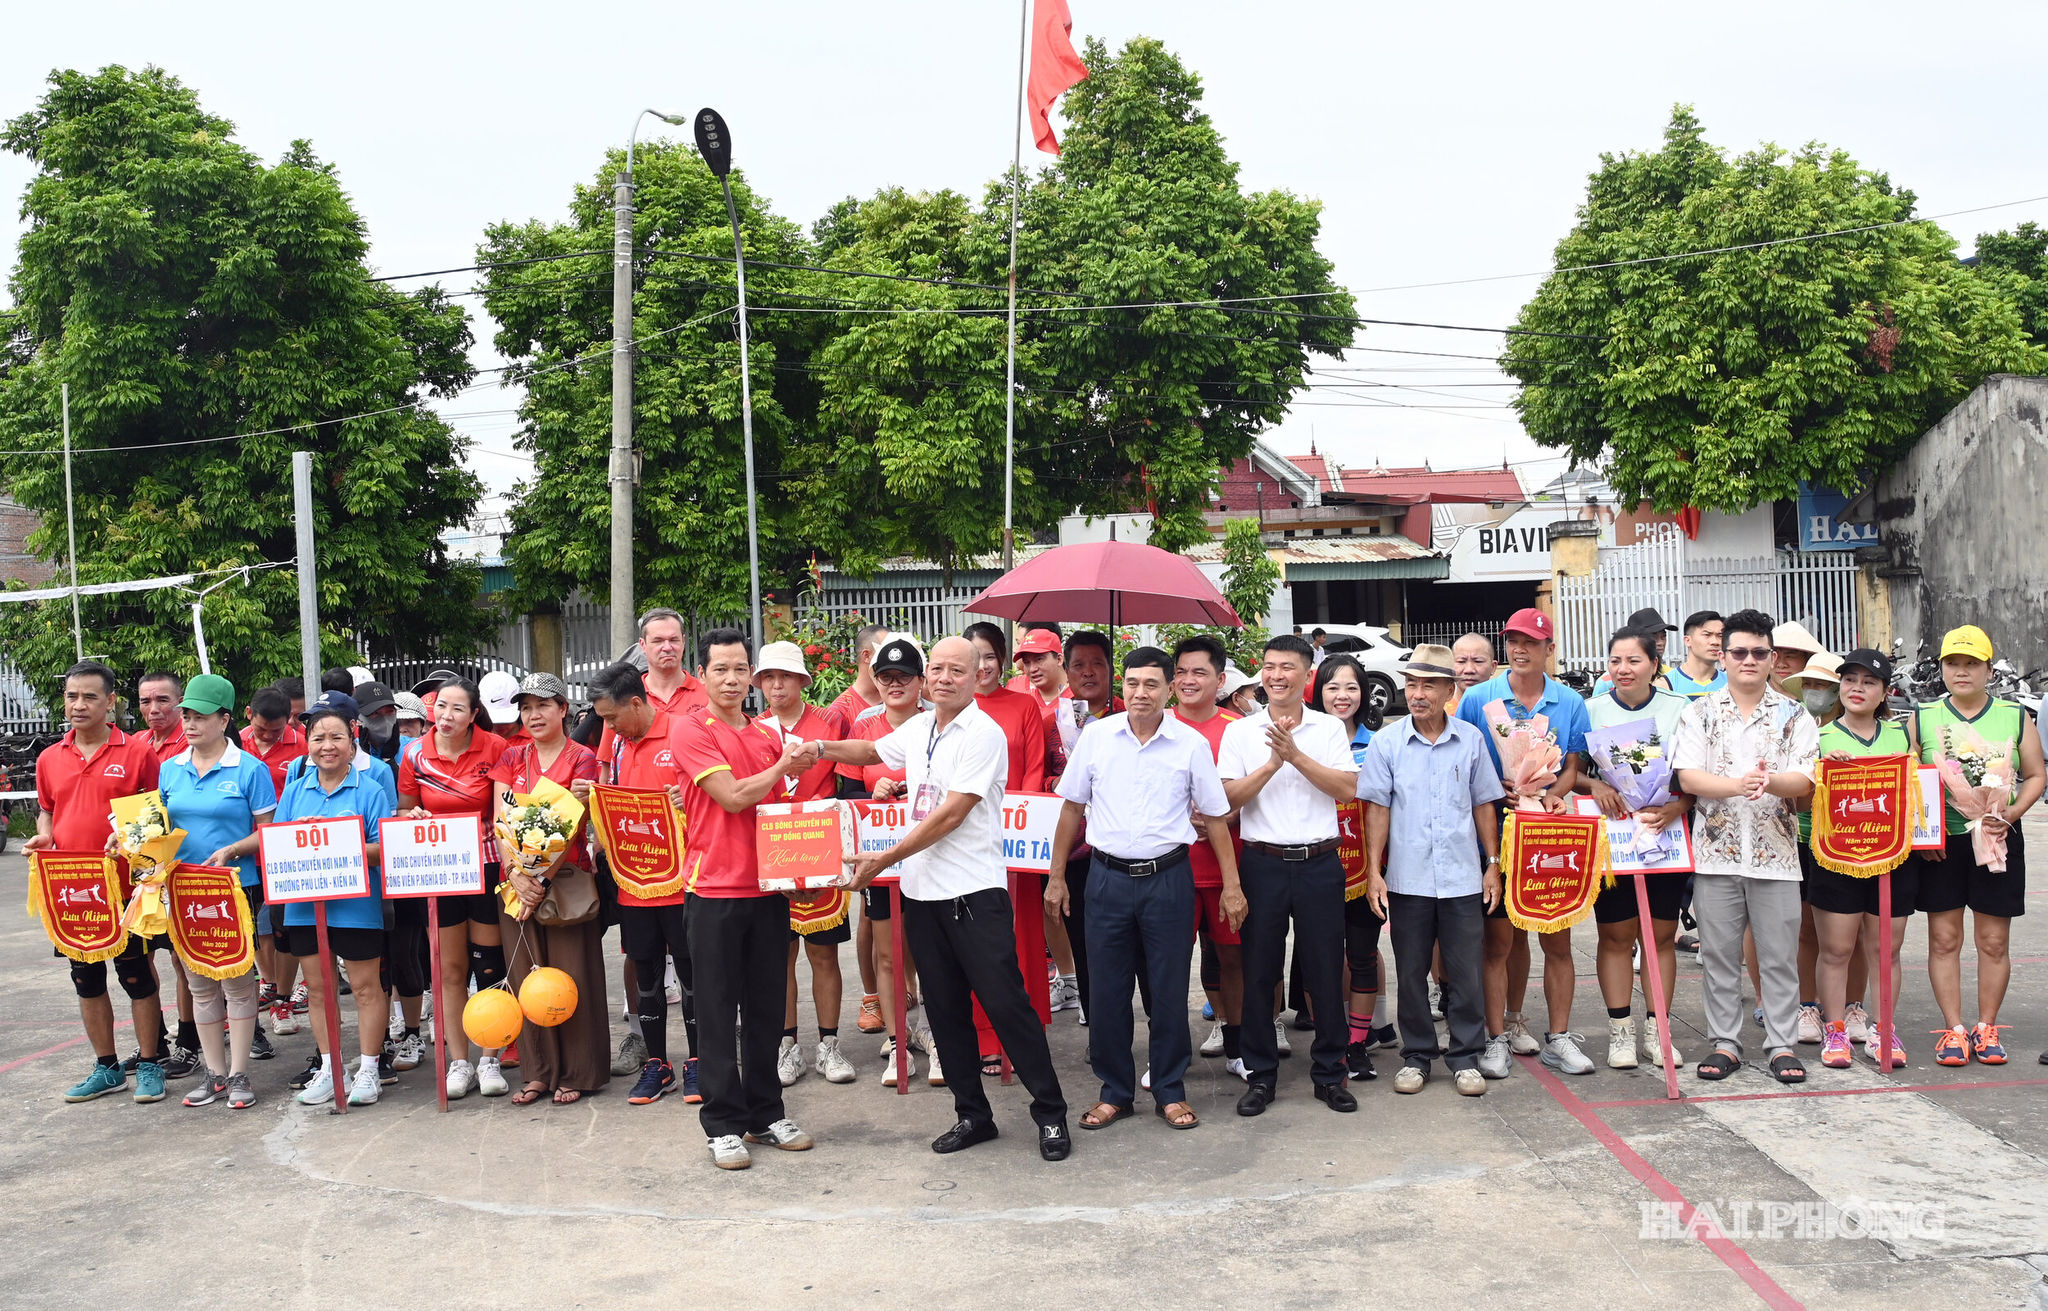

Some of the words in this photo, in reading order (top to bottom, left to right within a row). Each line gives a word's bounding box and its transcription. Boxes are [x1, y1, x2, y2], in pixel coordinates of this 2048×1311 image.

[1479, 528, 1518, 554] BIA
[871, 804, 905, 831] ĐỘI
[1003, 800, 1029, 830] TỔ
[296, 825, 329, 851] ĐỘI
[414, 821, 446, 847] ĐỘI
[803, 831, 825, 840] QUANG
[267, 863, 278, 875] CLB
[280, 859, 296, 873] BÓNG
[322, 857, 333, 870] HƠI
[334, 856, 348, 869] NAM
[393, 854, 408, 868] BÓNG
[433, 854, 443, 867] HƠI
[444, 853, 457, 866] NAM
[349, 875, 357, 886] AN
[386, 873, 401, 888] CÔNG
